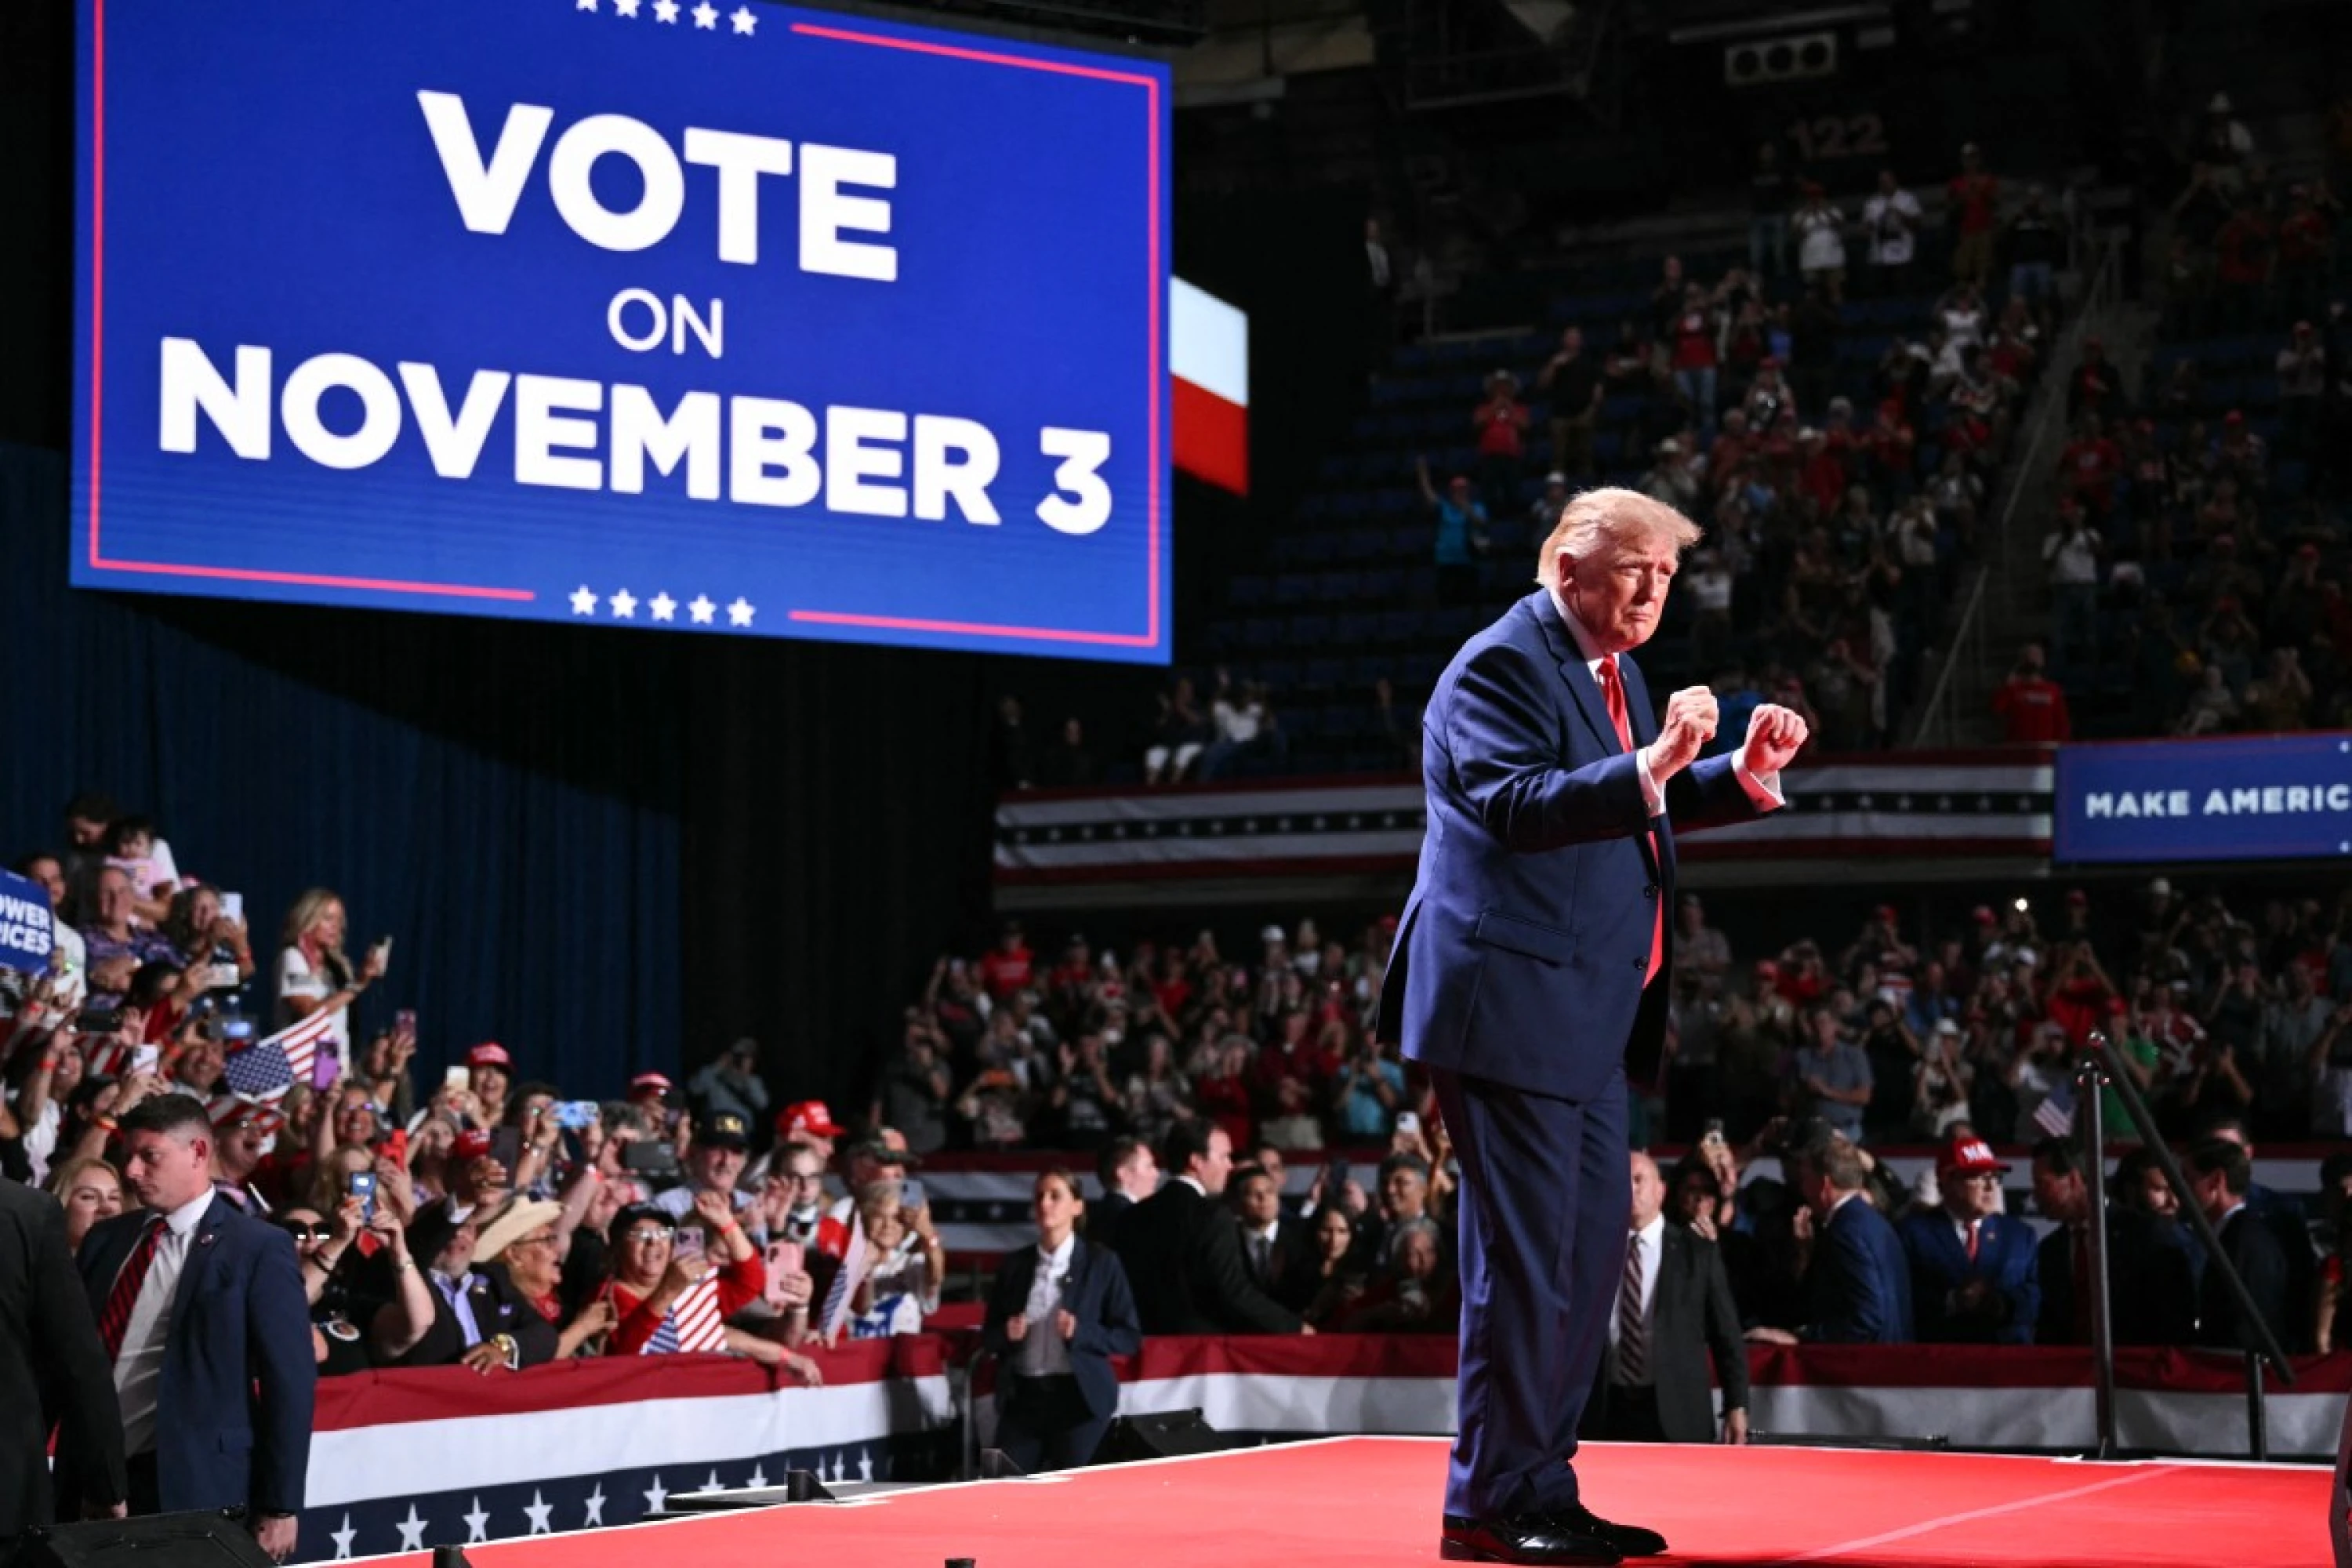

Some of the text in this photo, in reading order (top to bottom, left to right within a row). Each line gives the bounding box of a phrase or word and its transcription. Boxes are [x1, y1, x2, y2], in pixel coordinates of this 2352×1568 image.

[1785, 114, 1890, 161] 122
[417, 89, 898, 281] VOTE
[607, 288, 723, 359] ON
[160, 336, 1112, 535] NOVEMBER 3
[2085, 783, 2351, 818] MAKE AMERIC
[0, 922, 51, 956] ICES
